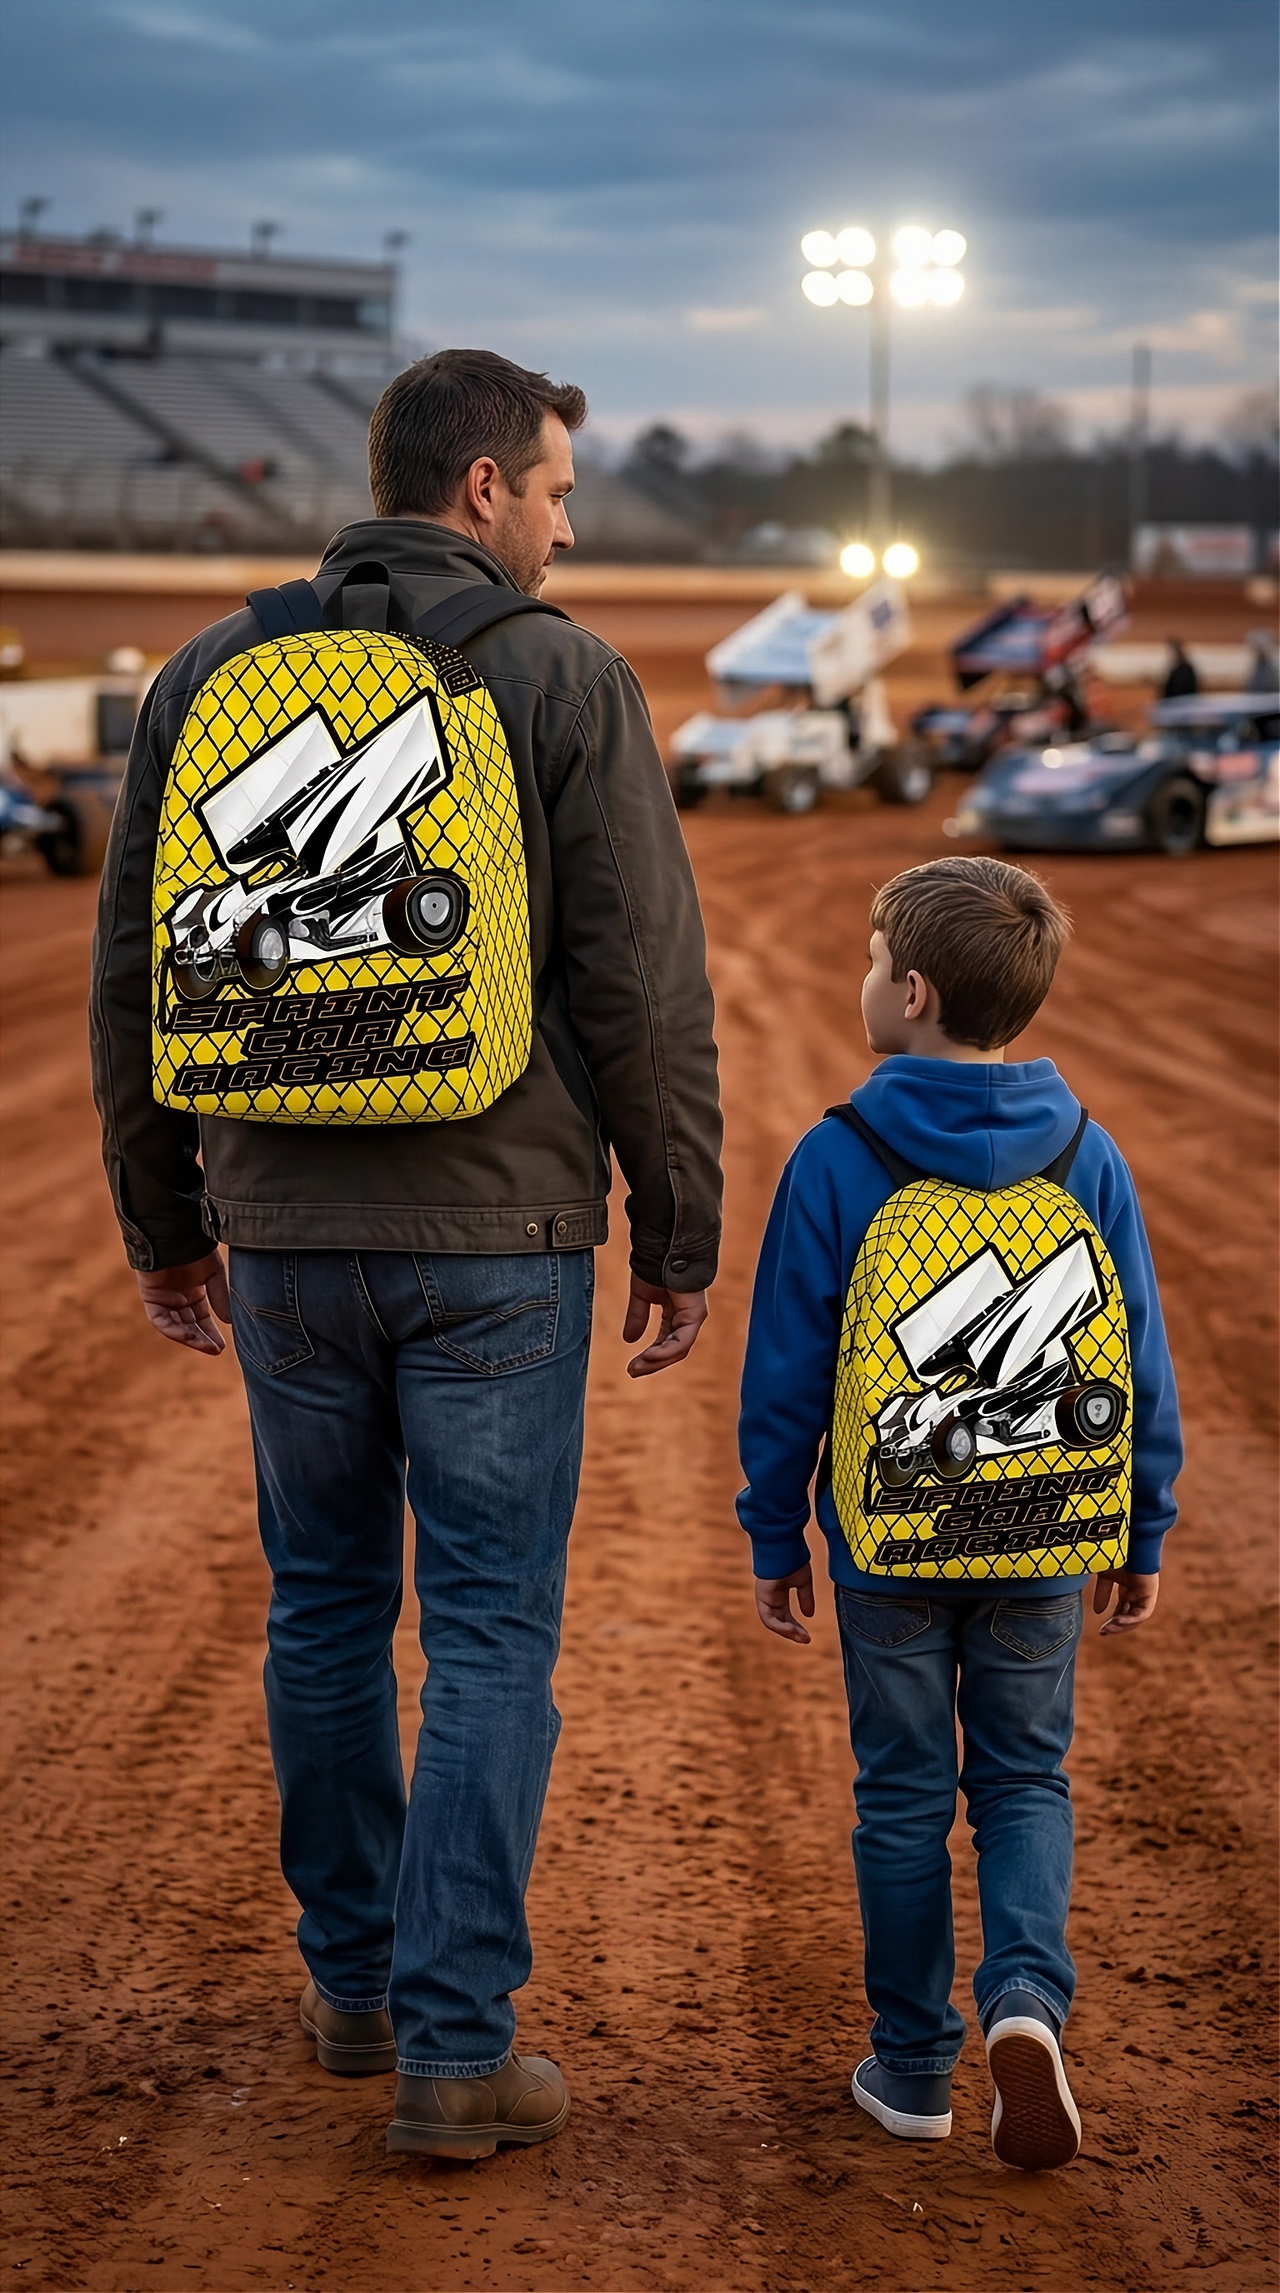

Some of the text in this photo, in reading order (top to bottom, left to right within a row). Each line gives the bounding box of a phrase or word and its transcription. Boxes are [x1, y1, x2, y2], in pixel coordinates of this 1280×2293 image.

[172, 978, 469, 1030] SPRINT
[247, 1020, 398, 1055] CAR
[177, 1038, 473, 1092] RACING
